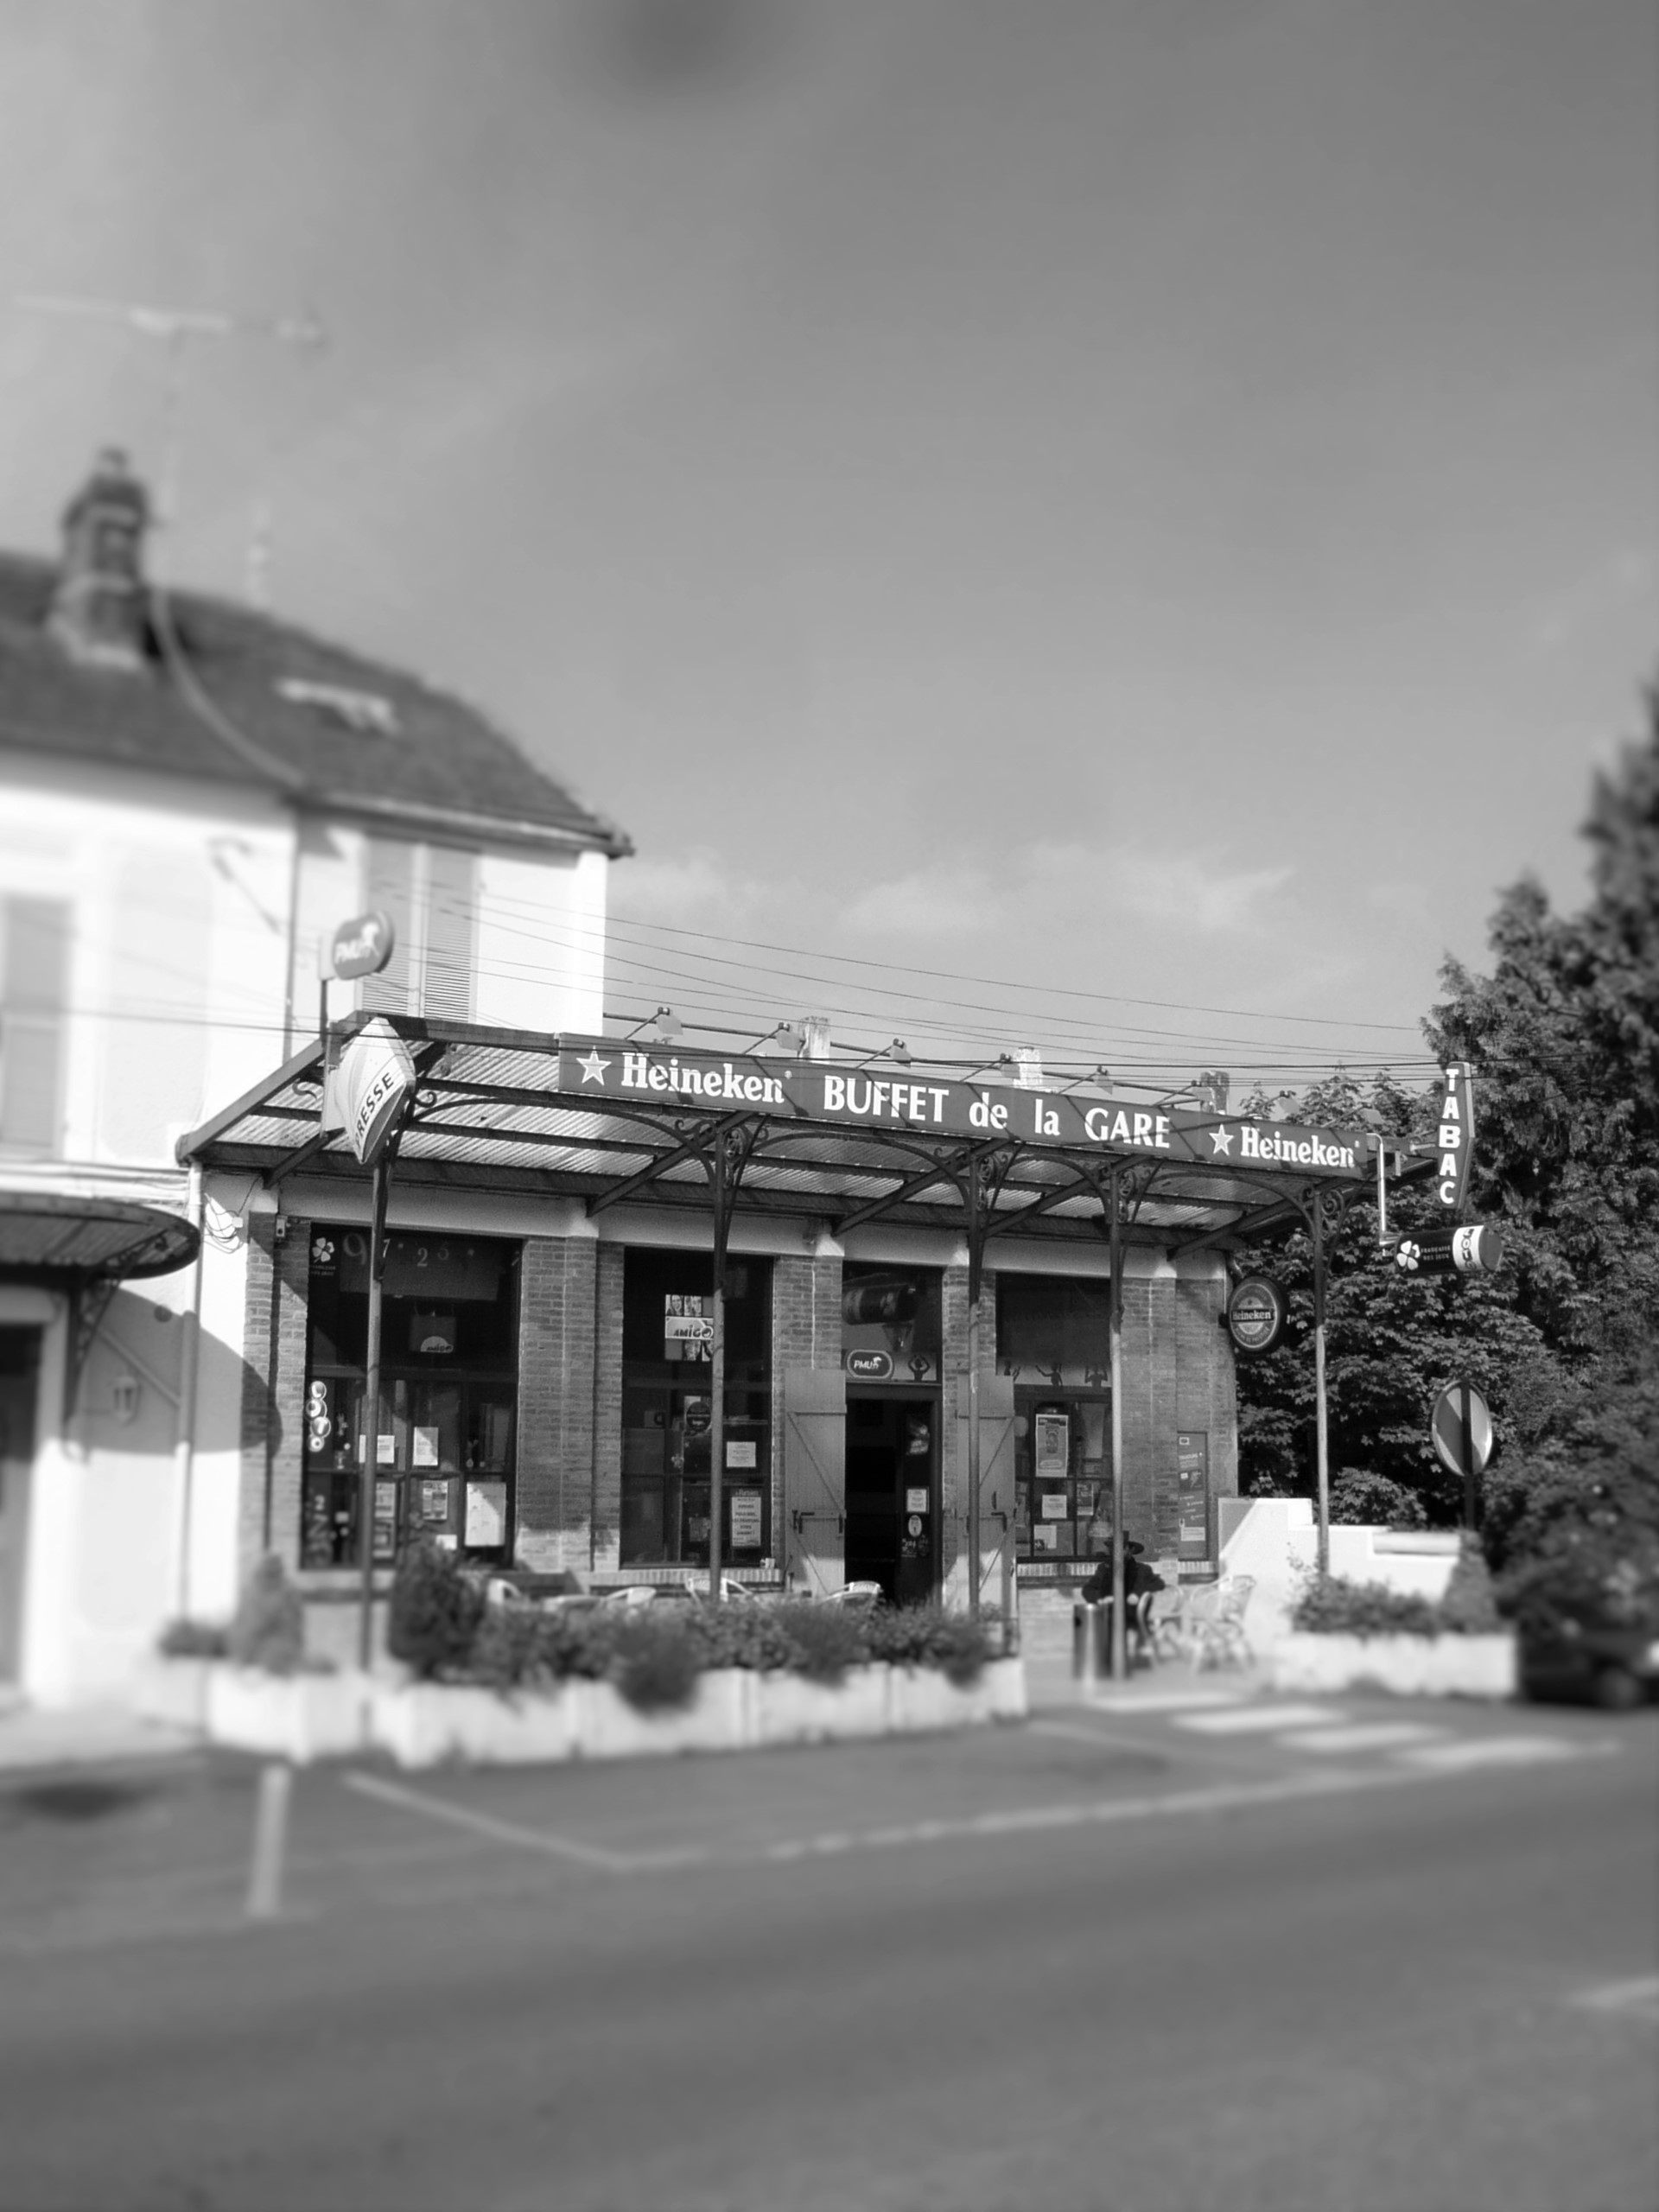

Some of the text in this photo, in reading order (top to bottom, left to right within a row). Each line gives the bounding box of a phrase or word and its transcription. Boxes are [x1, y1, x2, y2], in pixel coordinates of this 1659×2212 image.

[620, 1052, 785, 1104] Heineken
[355, 1072, 394, 1149] PRESSE
[823, 1074, 1170, 1149] BUFFET de la GARE
[1240, 1126, 1355, 1168] Heineken
[1439, 1069, 1461, 1205] TABAC
[1233, 1309, 1271, 1320] Heineken
[854, 1359, 873, 1370] PMU
